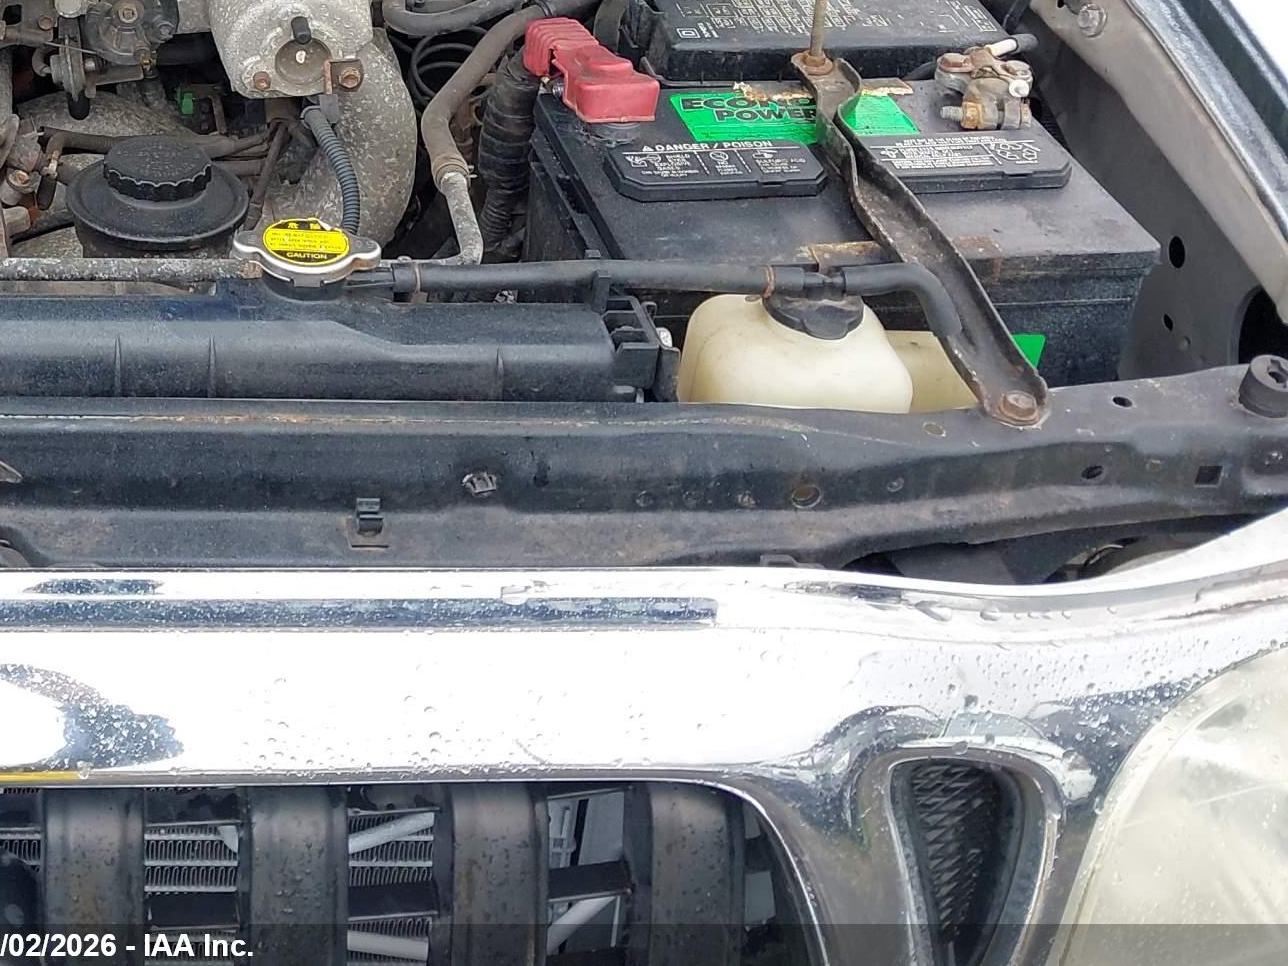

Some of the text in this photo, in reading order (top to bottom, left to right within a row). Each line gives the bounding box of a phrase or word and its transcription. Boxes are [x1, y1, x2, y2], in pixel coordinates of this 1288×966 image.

[655, 143, 710, 152] DANGER
[723, 140, 773, 149] POISON
[286, 251, 327, 259] CAUTION
